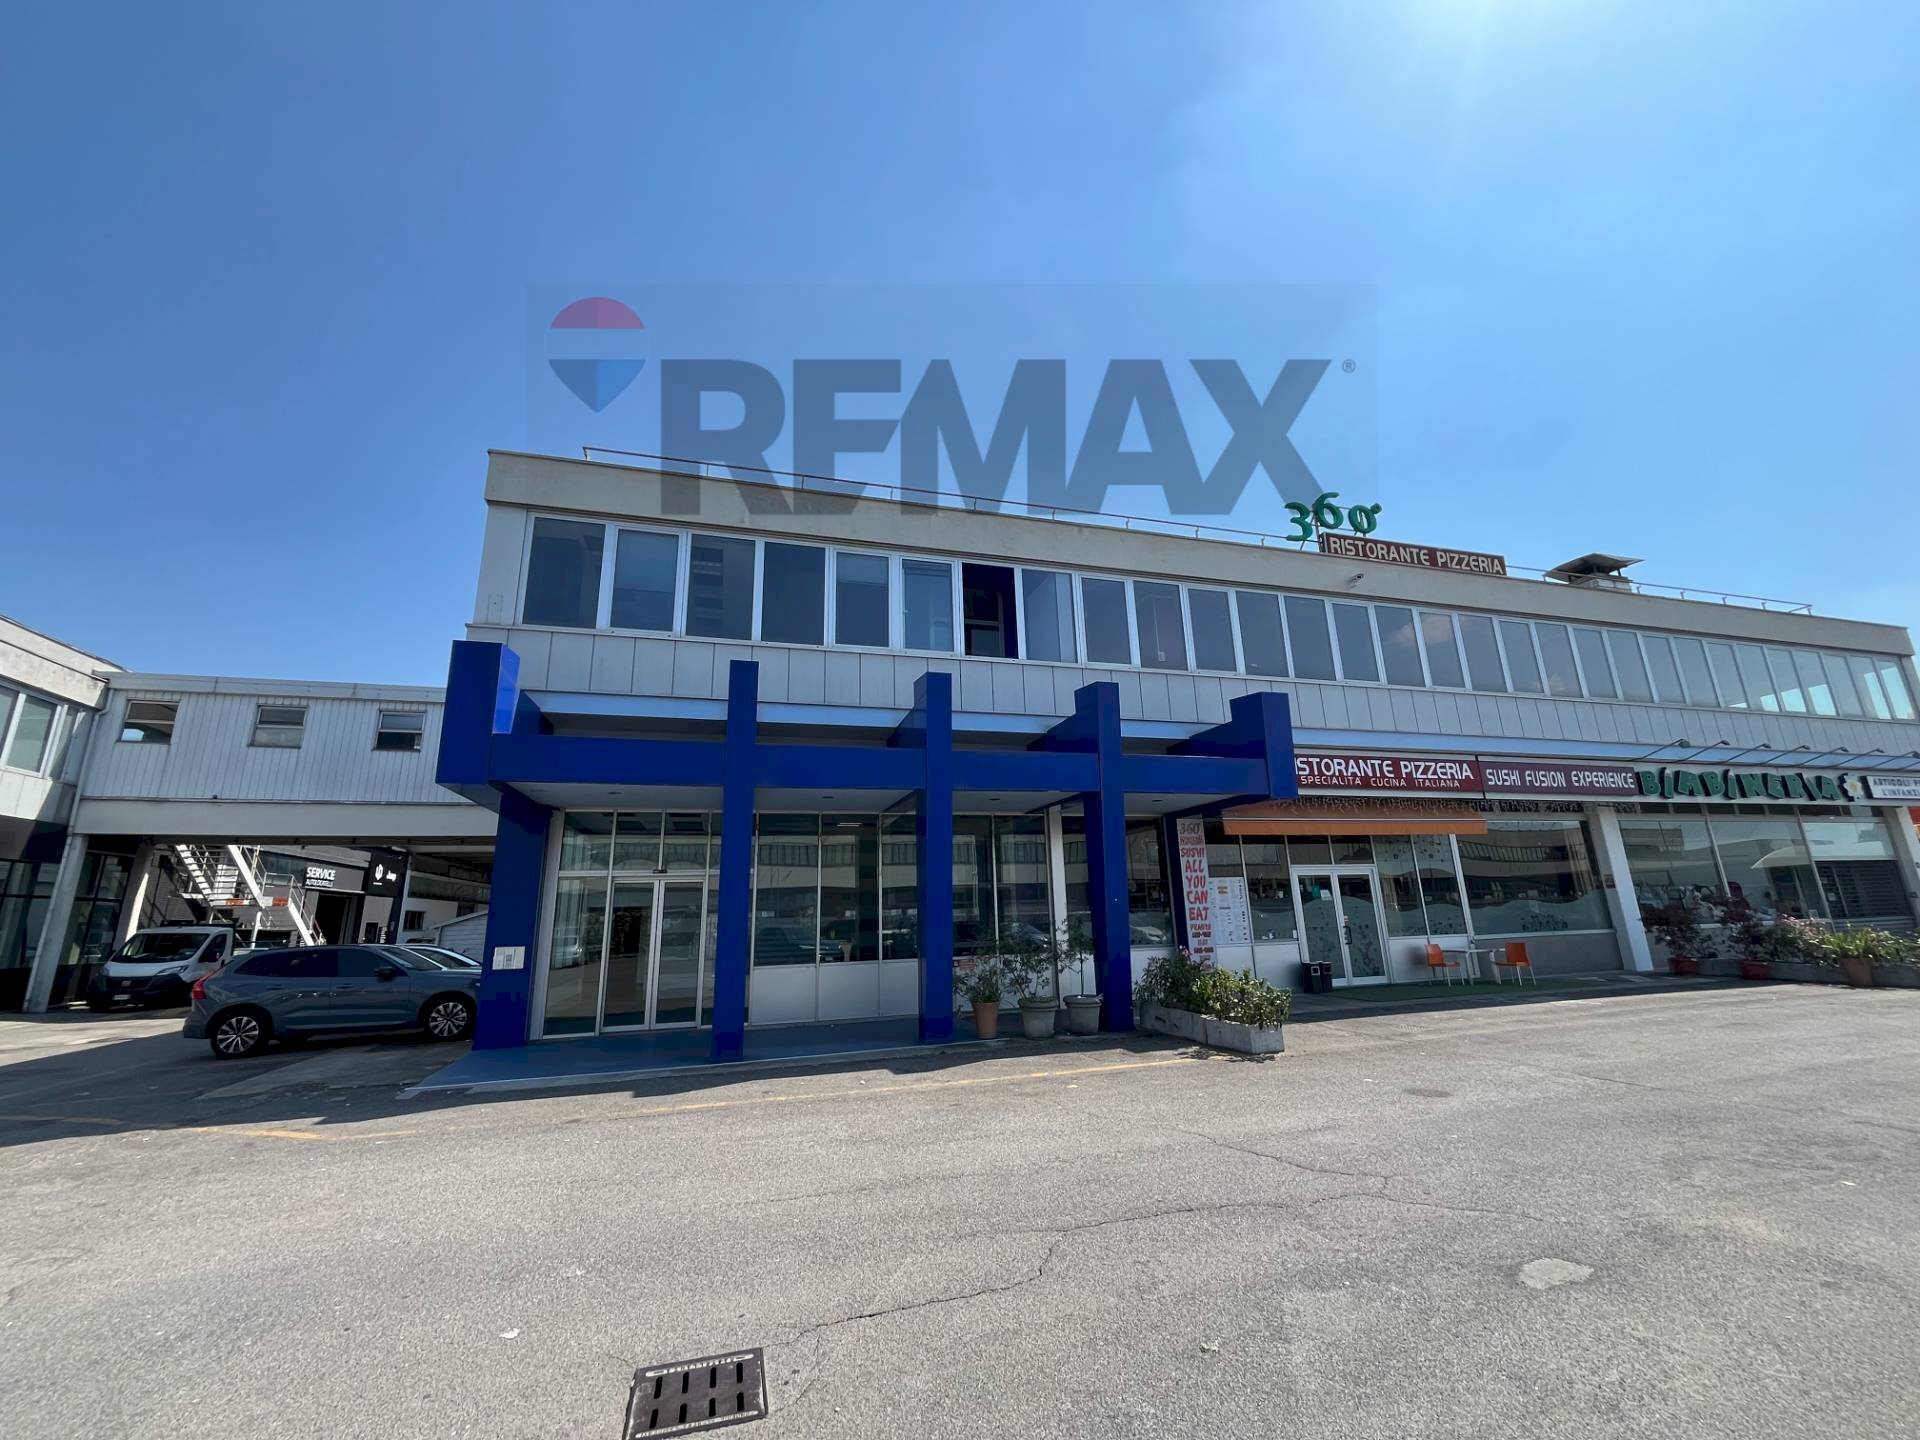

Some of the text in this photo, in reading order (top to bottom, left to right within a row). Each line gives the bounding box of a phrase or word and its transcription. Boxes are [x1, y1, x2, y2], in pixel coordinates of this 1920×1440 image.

[1329, 537, 1503, 575] RISTORANTE PIZZERIA
[1400, 761, 1474, 780] PIZZERIA
[1370, 777, 1407, 787] CUCINA
[1415, 778, 1461, 788] ITALIANA
[1486, 768, 1636, 789] SUSHI FUSION EXPERIENCE
[1181, 847, 1205, 858] SUSHI
[306, 866, 336, 880] SERVICE
[1185, 859, 1204, 873] ALL
[1185, 875, 1206, 888] YOU
[1186, 890, 1208, 904] CAN
[1189, 907, 1209, 921] EAT
